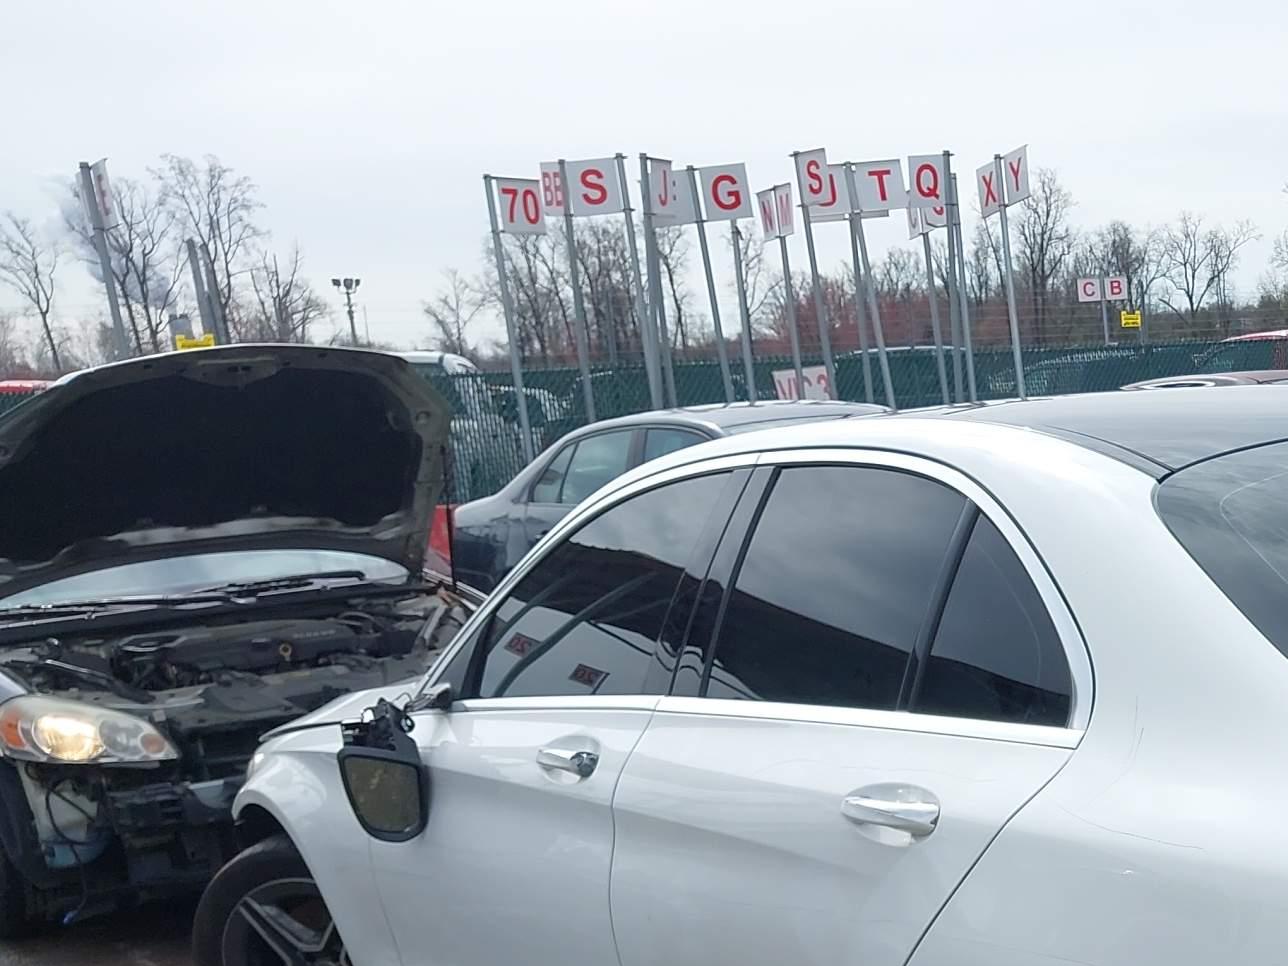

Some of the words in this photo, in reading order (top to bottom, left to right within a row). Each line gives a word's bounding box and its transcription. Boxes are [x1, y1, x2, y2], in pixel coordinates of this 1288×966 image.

[579, 168, 608, 206] S
[657, 168, 669, 208] J
[711, 174, 742, 211] G
[806, 160, 822, 195] S
[867, 169, 891, 201] T
[915, 163, 940, 200] Q
[981, 170, 997, 208] X
[1008, 156, 1022, 192] Y
[501, 187, 541, 225] 70
[1083, 281, 1096, 297] C
[1110, 280, 1122, 295] B
